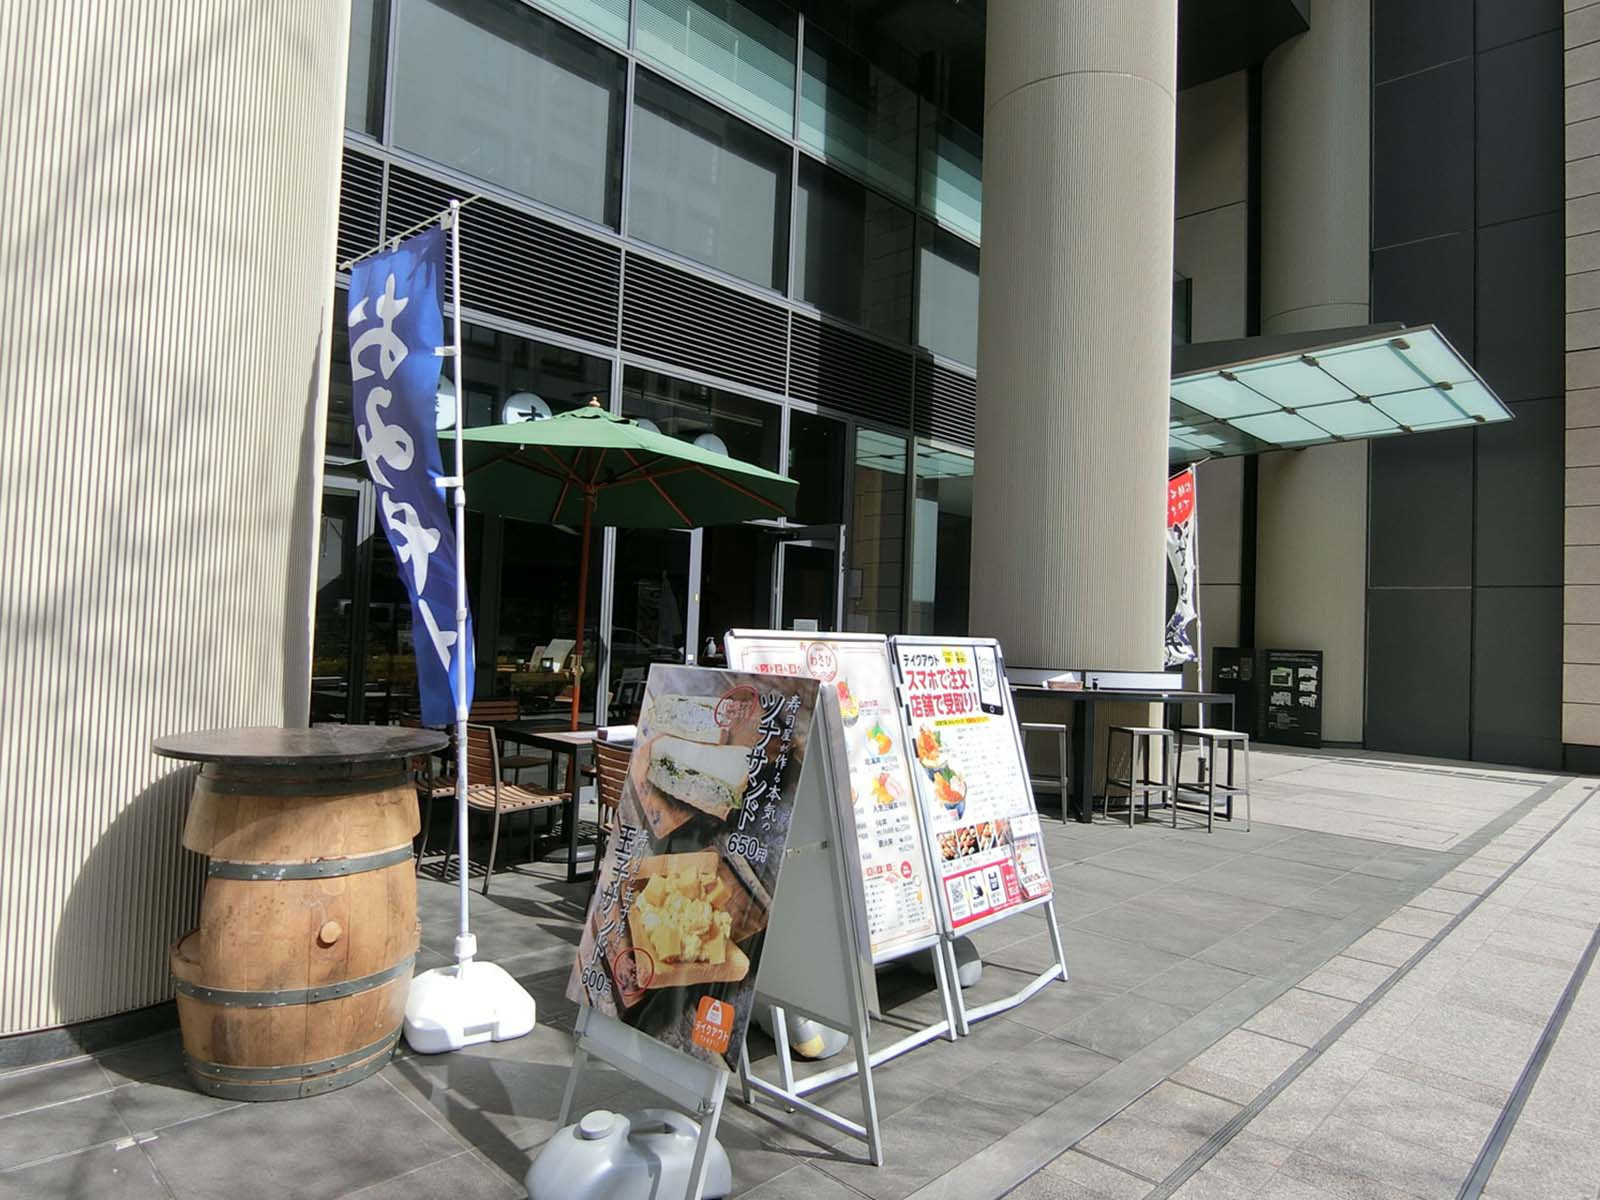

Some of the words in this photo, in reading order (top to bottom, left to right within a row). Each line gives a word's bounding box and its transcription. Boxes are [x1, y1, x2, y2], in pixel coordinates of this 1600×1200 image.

[903, 654, 940, 667] テイクアウト
[738, 692, 786, 832] ツナサンド
[727, 832, 768, 864] 650円
[694, 1021, 731, 1042] テイクアウト
